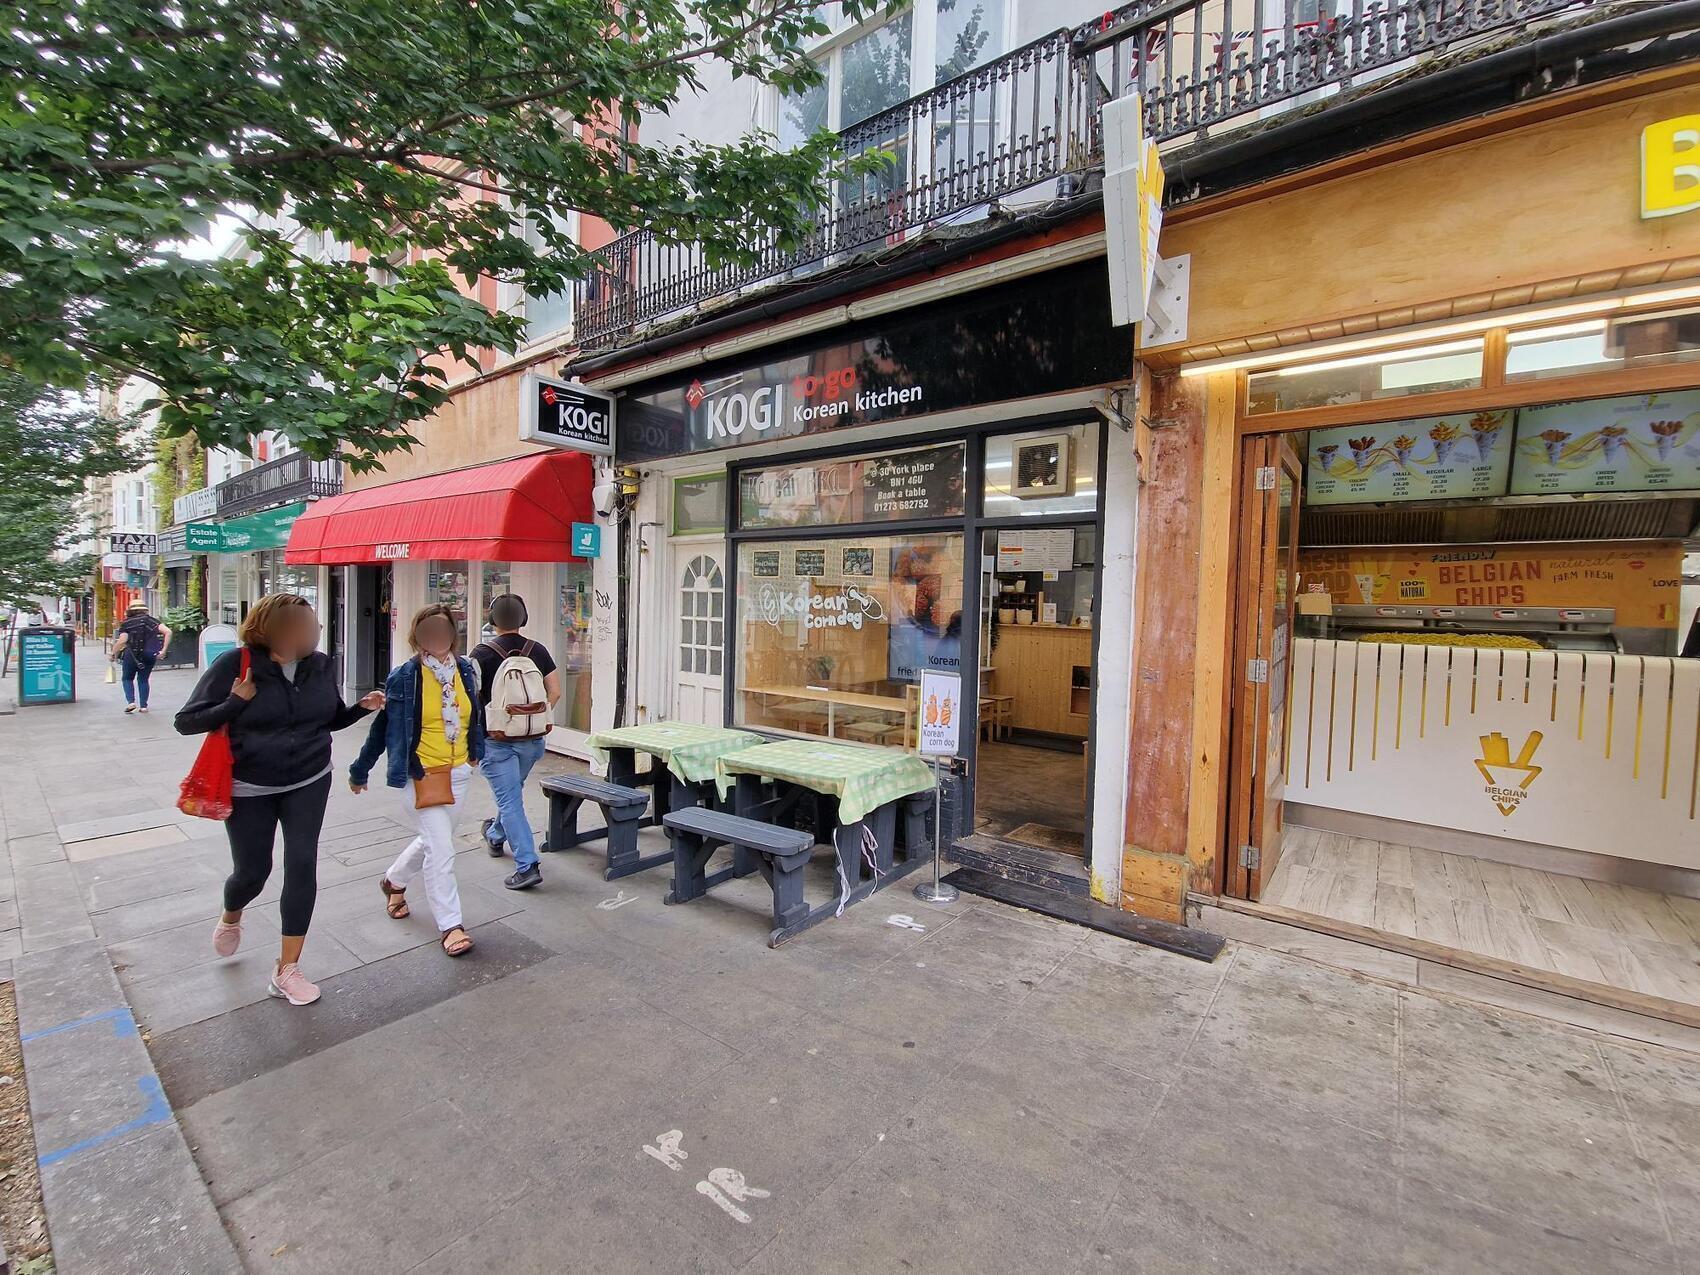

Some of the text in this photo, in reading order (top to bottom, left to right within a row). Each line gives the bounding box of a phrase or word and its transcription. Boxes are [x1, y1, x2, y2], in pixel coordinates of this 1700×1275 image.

[793, 386, 922, 422] Korean kitchen
[706, 384, 783, 440] KOGI
[559, 403, 608, 436] KOGI
[558, 427, 608, 444] Korean kitchen
[880, 467, 890, 477] 30
[892, 465, 910, 475] York
[911, 463, 935, 474] place
[890, 475, 923, 487] BN1 4GU
[877, 490, 897, 500] Book
[905, 487, 927, 497] table
[874, 499, 929, 512] 01273 682752
[111, 533, 155, 545] TAXI
[190, 528, 218, 537] Estate
[190, 537, 218, 546] Agent
[375, 543, 410, 559] WELCOME
[1550, 552, 1616, 569] natural
[1439, 560, 1541, 584] BELGIAN
[1553, 571, 1578, 583] FARM
[1456, 585, 1525, 606] CHIPS
[780, 591, 848, 614] Korean
[928, 655, 960, 667] Korean
[923, 730, 945, 738] Korean
[944, 739, 955, 748] dog
[1484, 786, 1528, 799] BELGIAN
[1491, 795, 1520, 805] CHIPS
